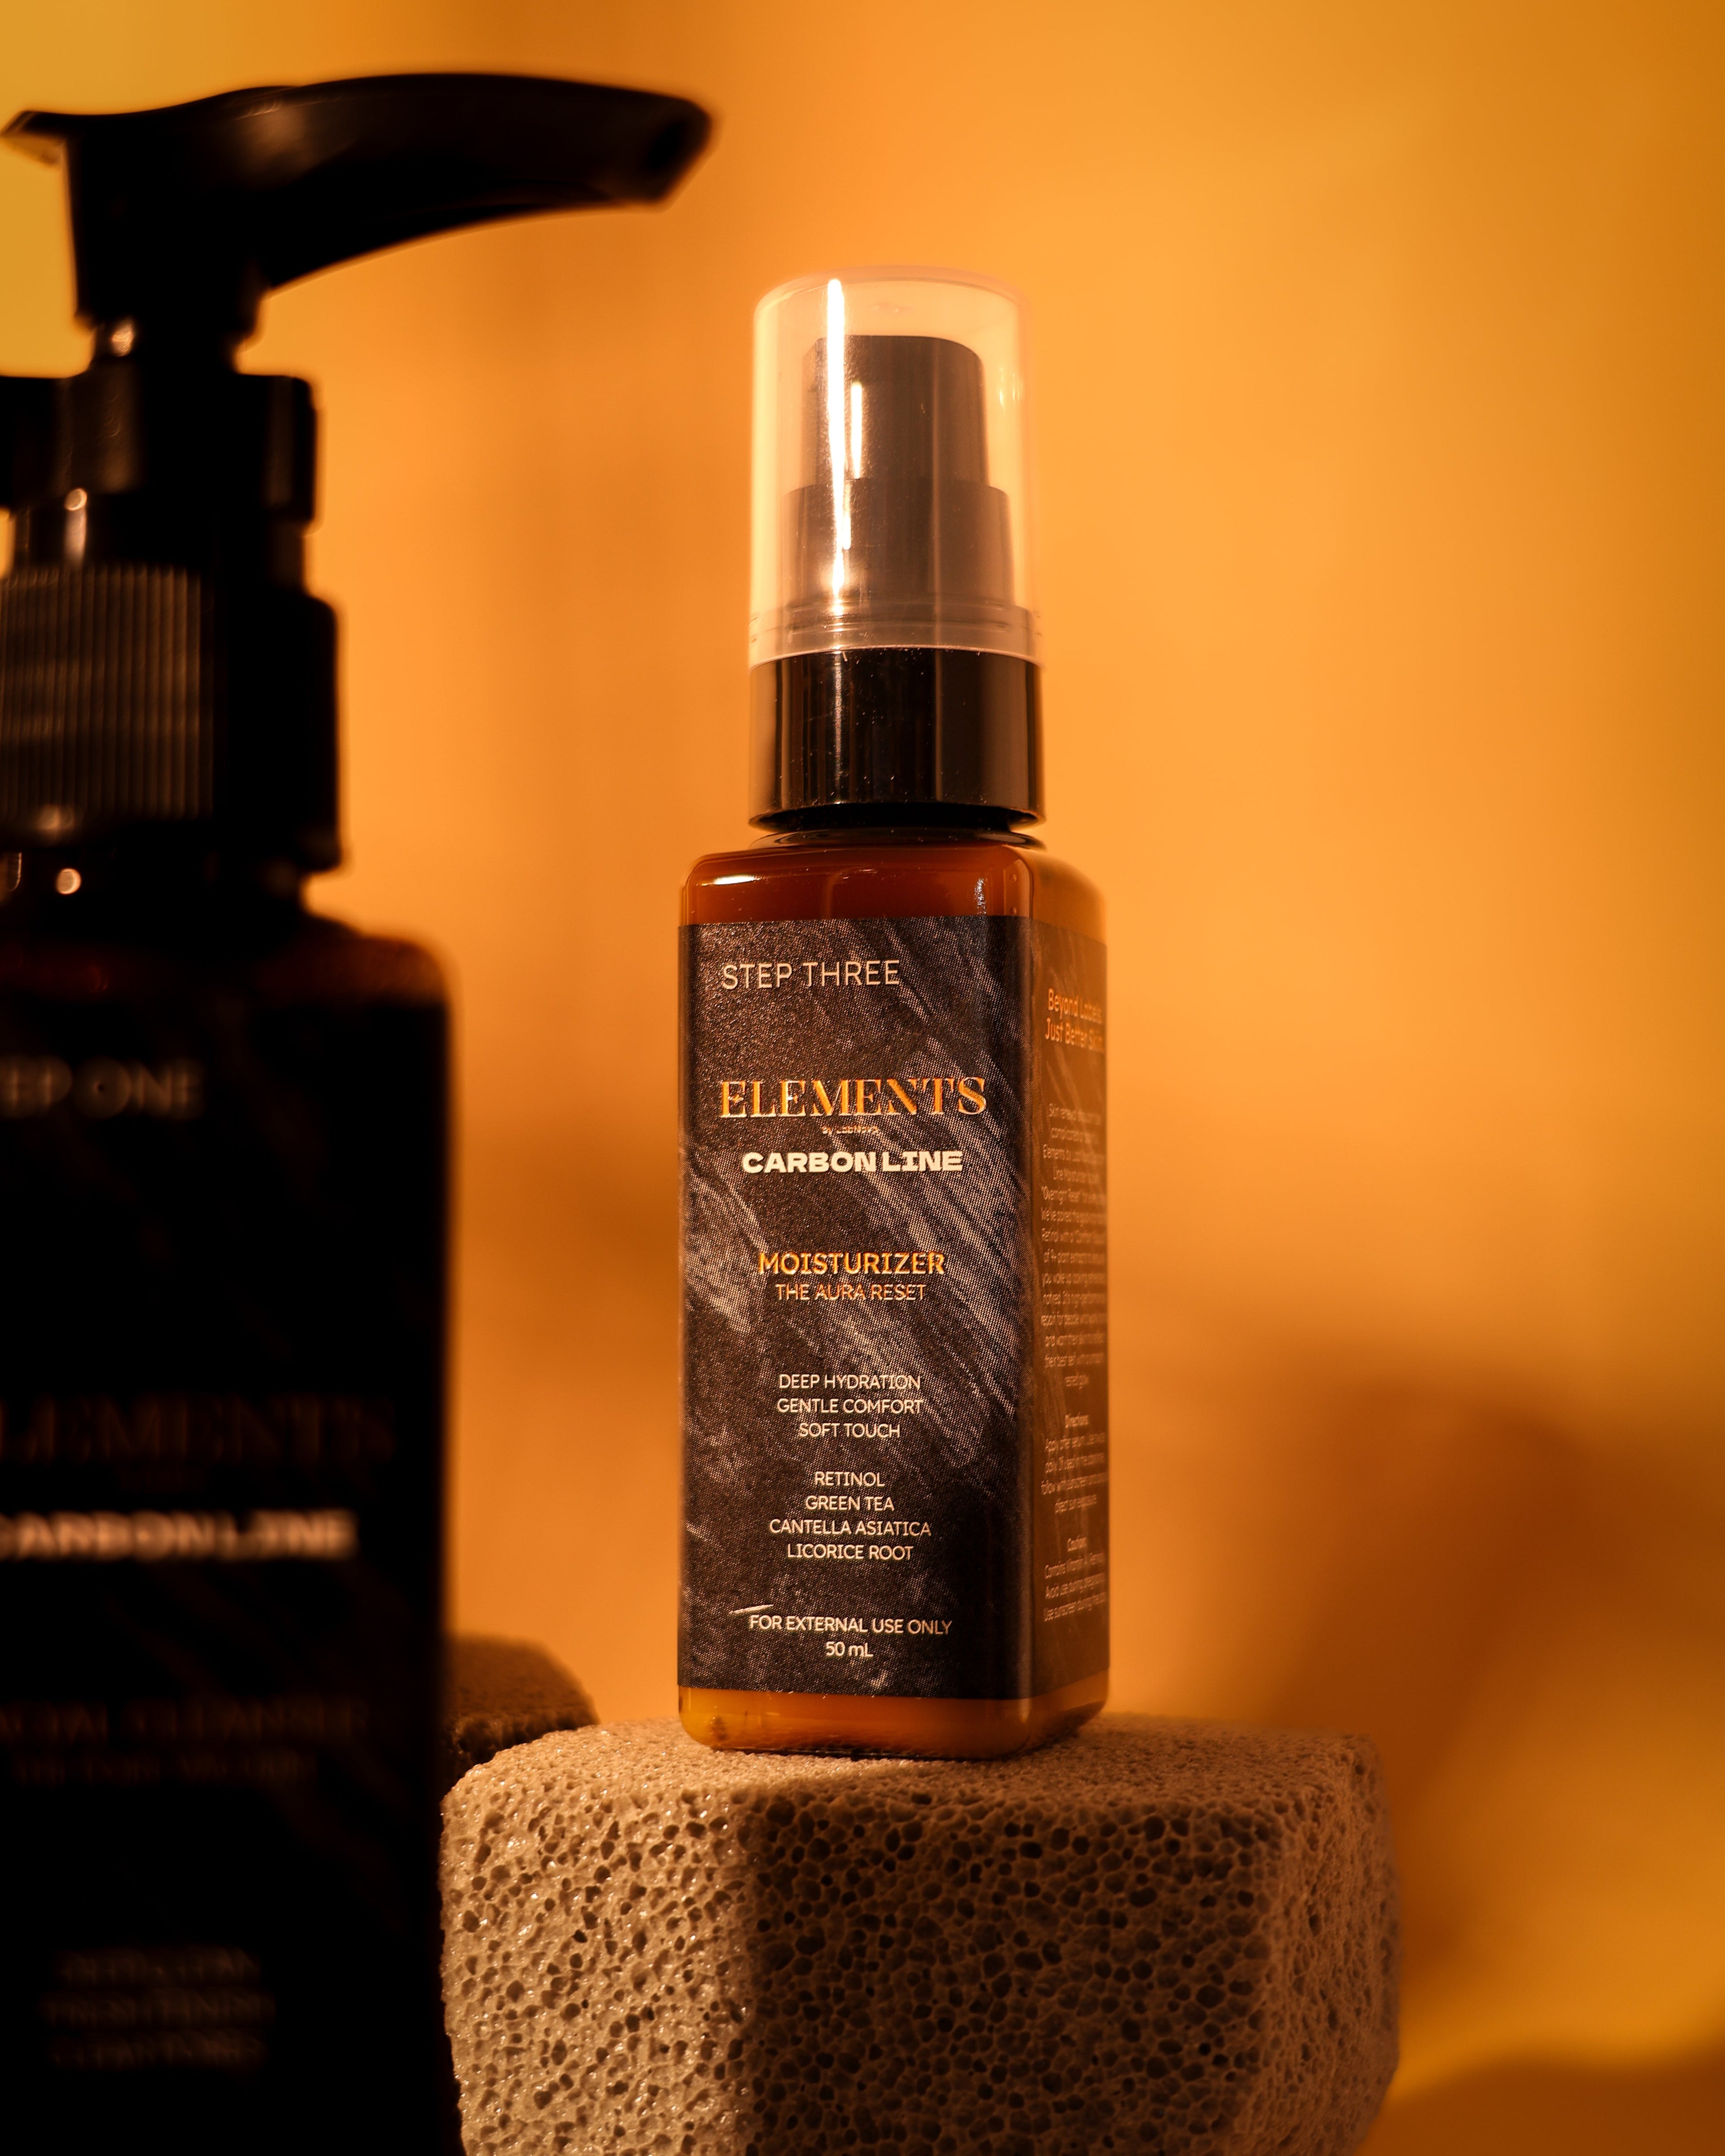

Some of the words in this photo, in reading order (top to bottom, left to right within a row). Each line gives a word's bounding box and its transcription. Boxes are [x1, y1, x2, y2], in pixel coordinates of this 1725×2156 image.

[721, 962, 792, 990] STEP
[803, 959, 900, 988] THREE
[1048, 987, 1079, 1020] Beyond
[1044, 1016, 1064, 1043] Just
[720, 1076, 987, 1118] ELEMENTS
[758, 1251, 945, 1275] MOISTURIZER
[775, 1283, 810, 1301] THE
[814, 1283, 866, 1301] AURA
[870, 1283, 926, 1300] RESET
[779, 1374, 820, 1390] DEEP
[825, 1374, 921, 1391] HYDRATION
[777, 1398, 839, 1414] GENTLE
[843, 1398, 924, 1414] COMFORT
[799, 1423, 839, 1438] SOFT
[843, 1423, 900, 1438] TOUCH
[814, 1471, 885, 1488] RETINOL
[805, 1495, 861, 1511] GREEN
[864, 1496, 895, 1512] TEA
[770, 1519, 852, 1536] CANTELLA
[855, 1520, 932, 1537] ASIATICA
[787, 1543, 864, 1560] LICORICE
[869, 1545, 914, 1561] ROOT
[749, 1615, 783, 1631] FOR
[786, 1615, 868, 1634] EXTERNAL
[872, 1618, 904, 1634] USE
[907, 1619, 953, 1635] ONLY
[825, 1641, 845, 1657] 50
[849, 1641, 874, 1658] mL
